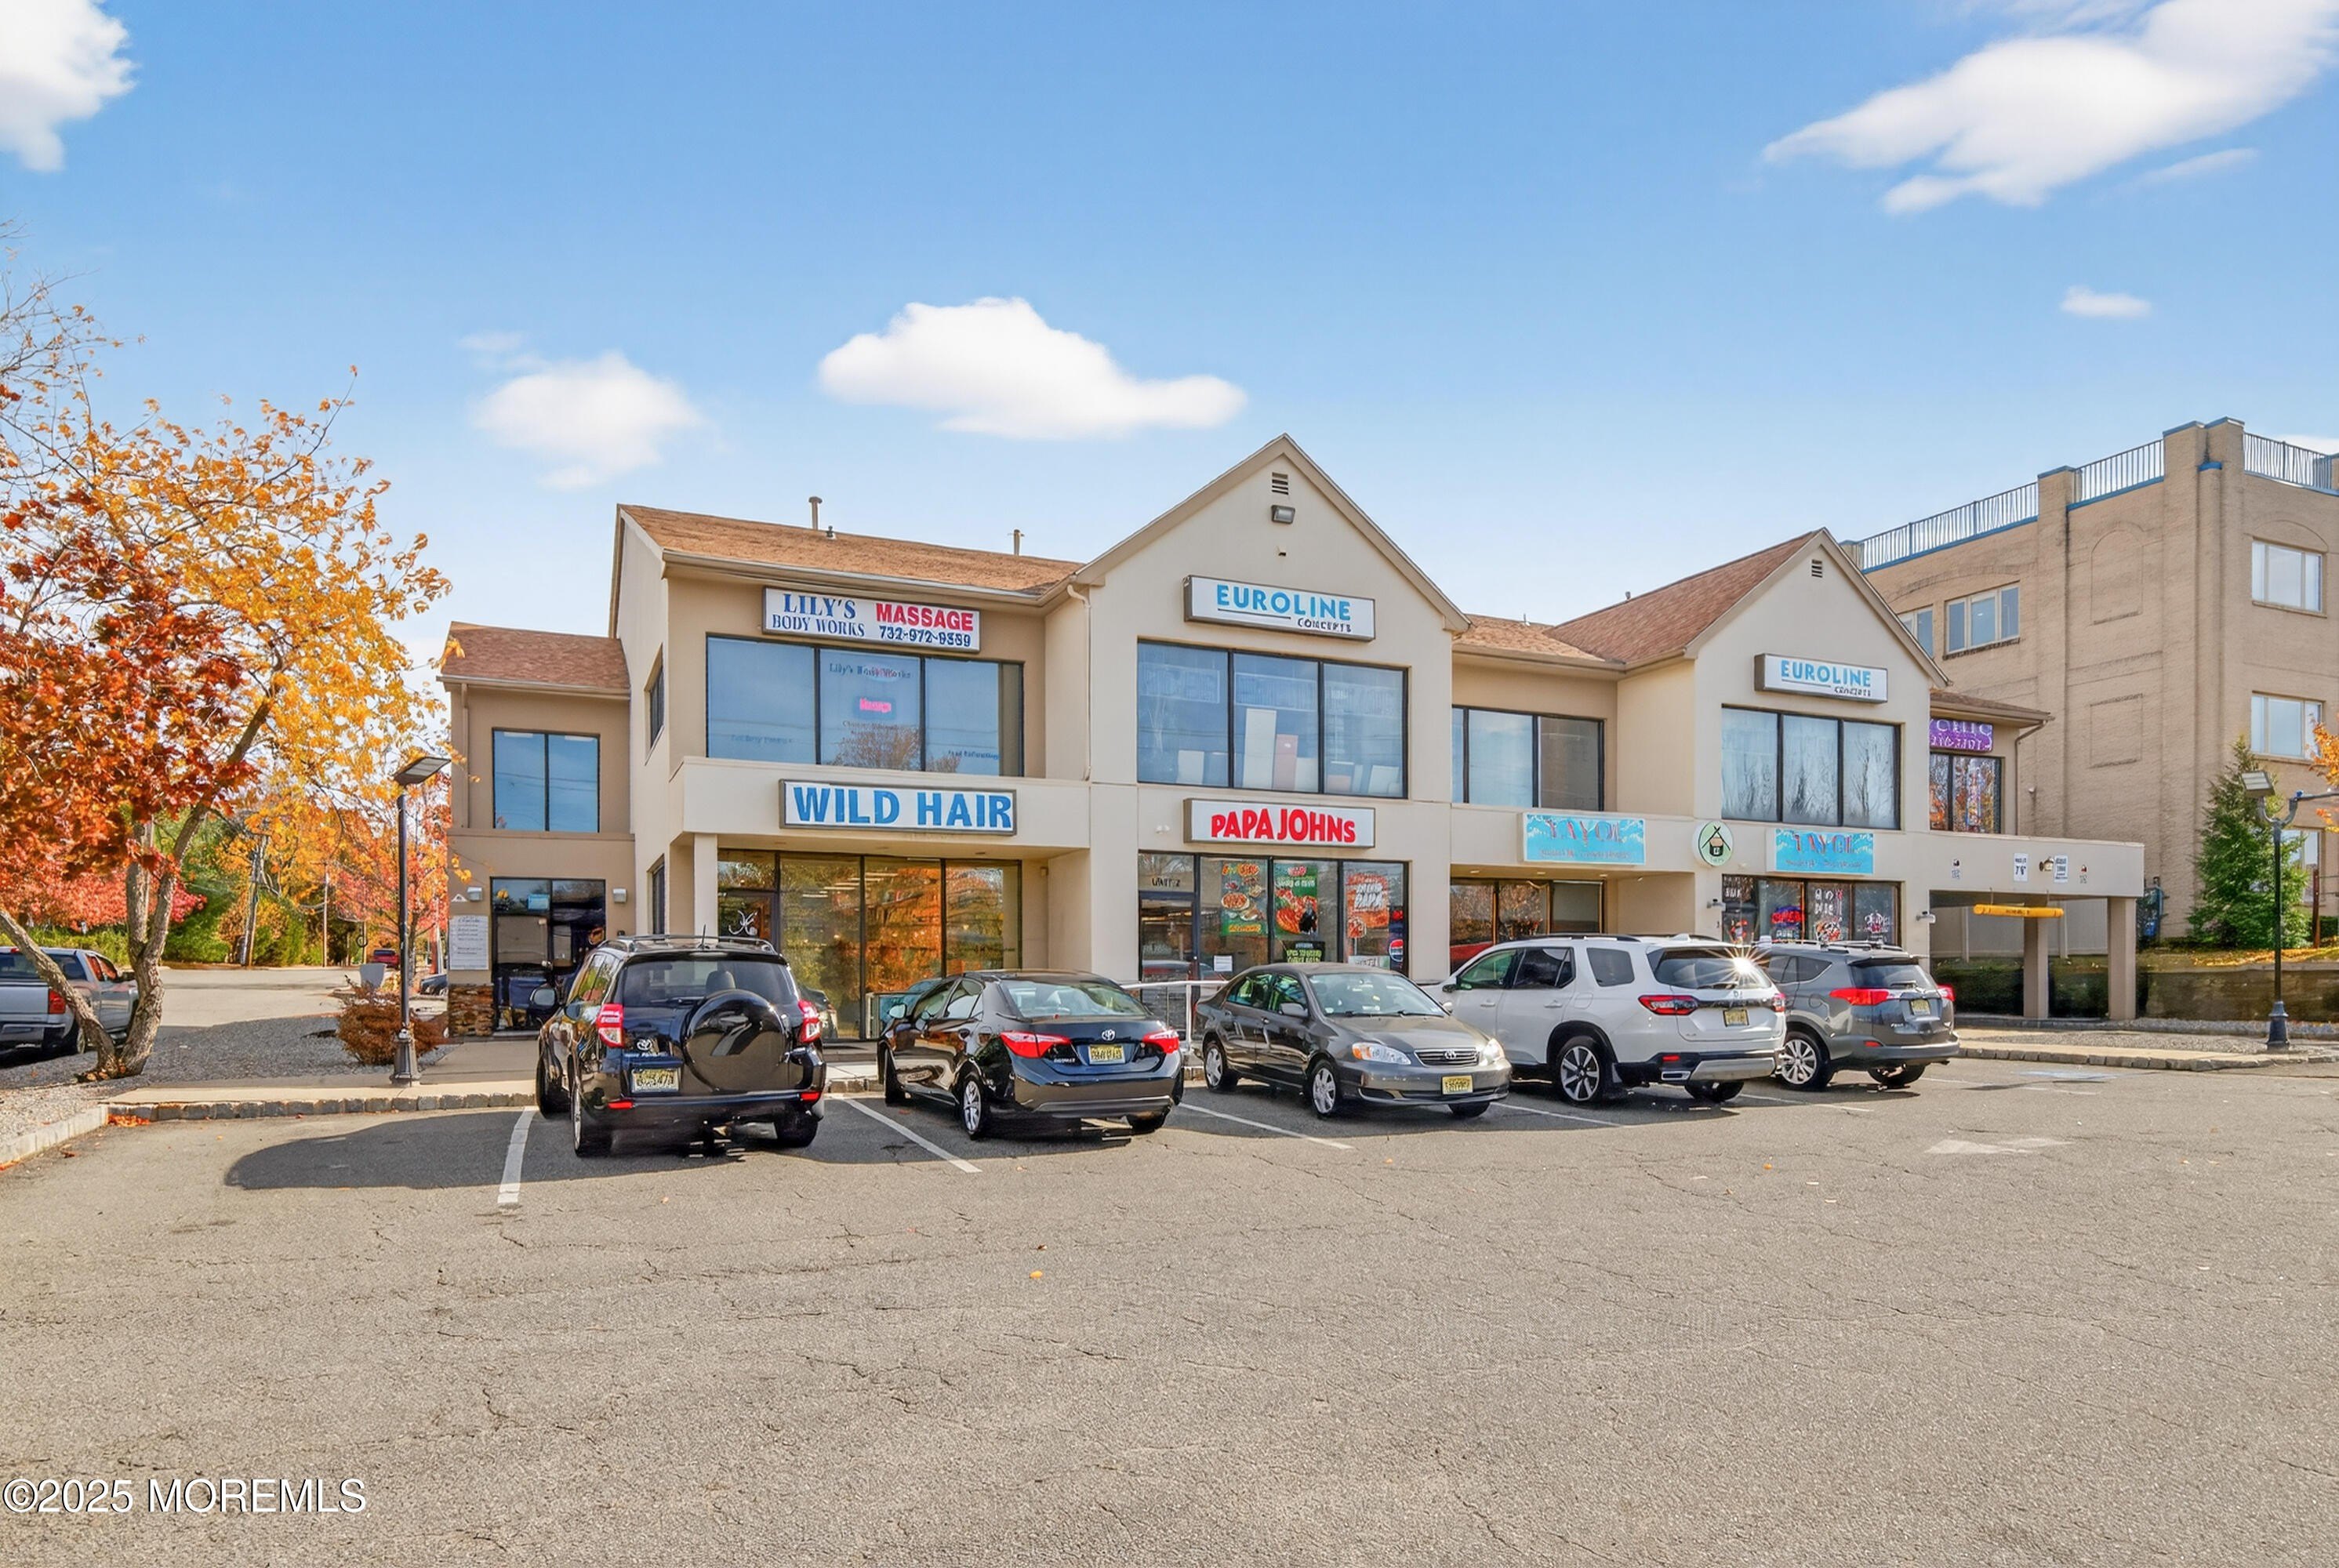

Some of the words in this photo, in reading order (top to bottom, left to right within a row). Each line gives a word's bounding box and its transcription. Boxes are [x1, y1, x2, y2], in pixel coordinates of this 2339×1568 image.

[783, 593, 856, 619] LILY'S
[876, 603, 974, 631] MASSAGE
[1217, 584, 1351, 621] EUROLINE
[772, 614, 811, 632] BODY
[815, 619, 865, 637] WORKS
[1781, 659, 1871, 688] EUROLINE
[794, 786, 899, 825] WILD
[917, 792, 1012, 828] HAIR
[1211, 808, 1274, 840] PAPA
[1277, 808, 1357, 843] JOHNS
